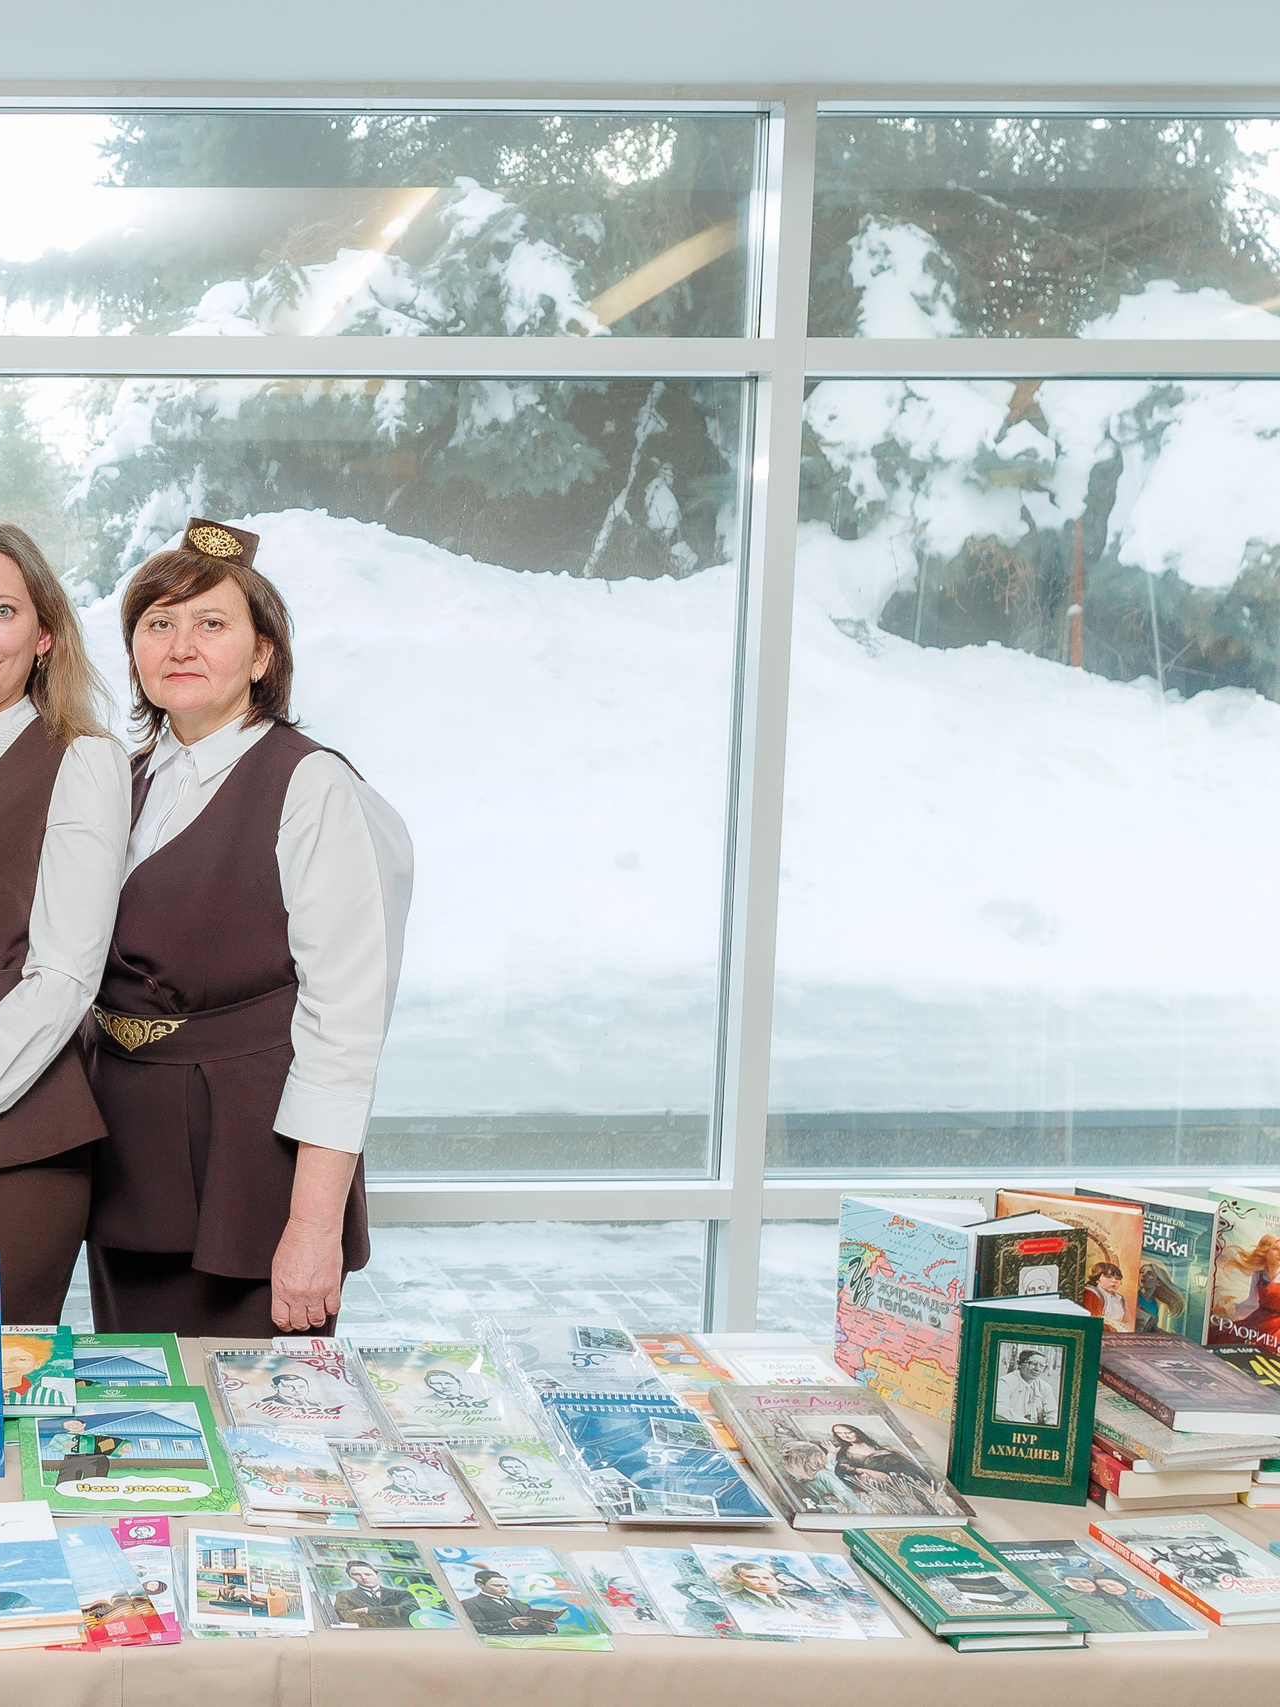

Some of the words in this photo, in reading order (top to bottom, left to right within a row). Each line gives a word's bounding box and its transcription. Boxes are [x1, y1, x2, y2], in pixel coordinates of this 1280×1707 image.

[1143, 1220, 1175, 1239] ЕНТ
[1143, 1235, 1189, 1258] РАКА
[247, 1401, 293, 1415] Муса
[750, 1395, 801, 1407] Тайна
[1012, 1432, 1039, 1445] НУР
[988, 1446, 1060, 1462] АХМАДИЕВ
[76, 1483, 119, 1493] Наш
[123, 1484, 192, 1494] земляк
